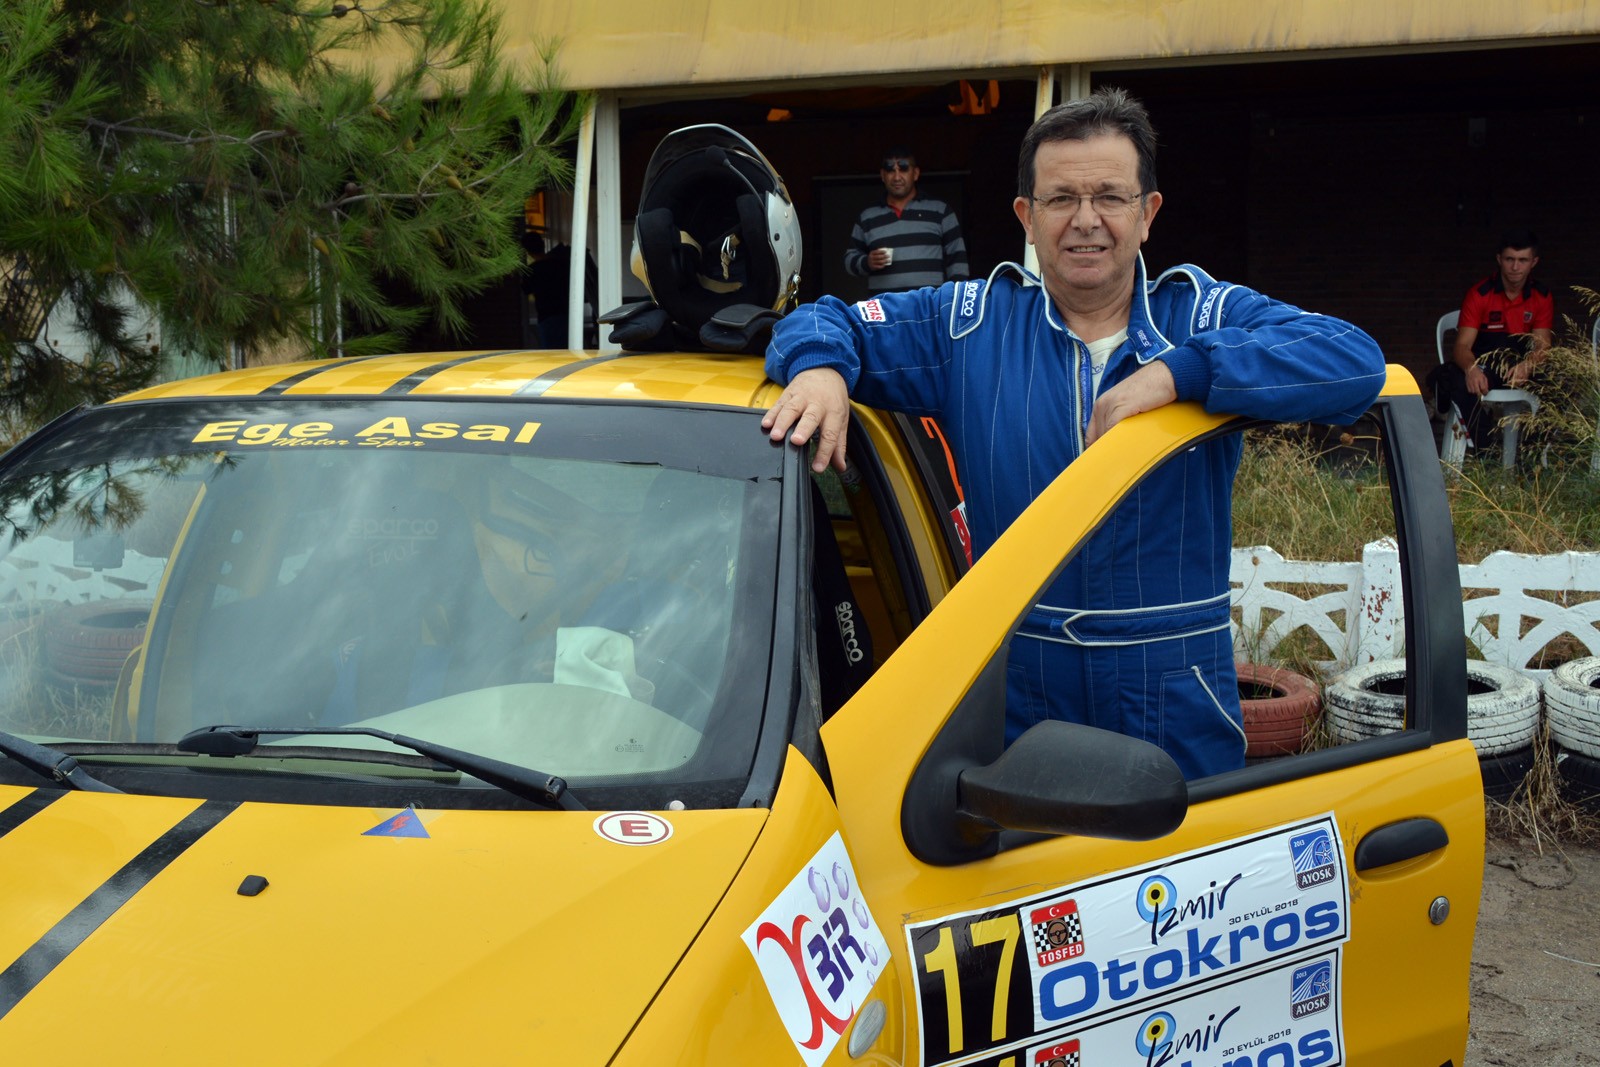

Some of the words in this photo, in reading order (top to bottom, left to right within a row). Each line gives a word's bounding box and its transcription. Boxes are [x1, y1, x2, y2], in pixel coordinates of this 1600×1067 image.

[191, 420, 334, 445] Ege
[354, 416, 542, 444] Asal
[272, 437, 350, 447] Motor
[357, 436, 426, 448] Spor
[836, 601, 864, 664] sparco
[619, 819, 653, 838] E
[1301, 867, 1332, 886] AYOSK
[1228, 915, 1242, 926] 30
[1244, 906, 1273, 921] EYLÜL
[1274, 898, 1299, 912] 2018
[1038, 899, 1340, 1022] Otokros
[1040, 943, 1083, 965] TOSFED
[923, 912, 1020, 1054] 17
[1296, 996, 1327, 1016] AYOSK
[1222, 1047, 1236, 1058] 30
[1237, 1037, 1267, 1053] EYLÜL
[1267, 1028, 1292, 1043] 2018
